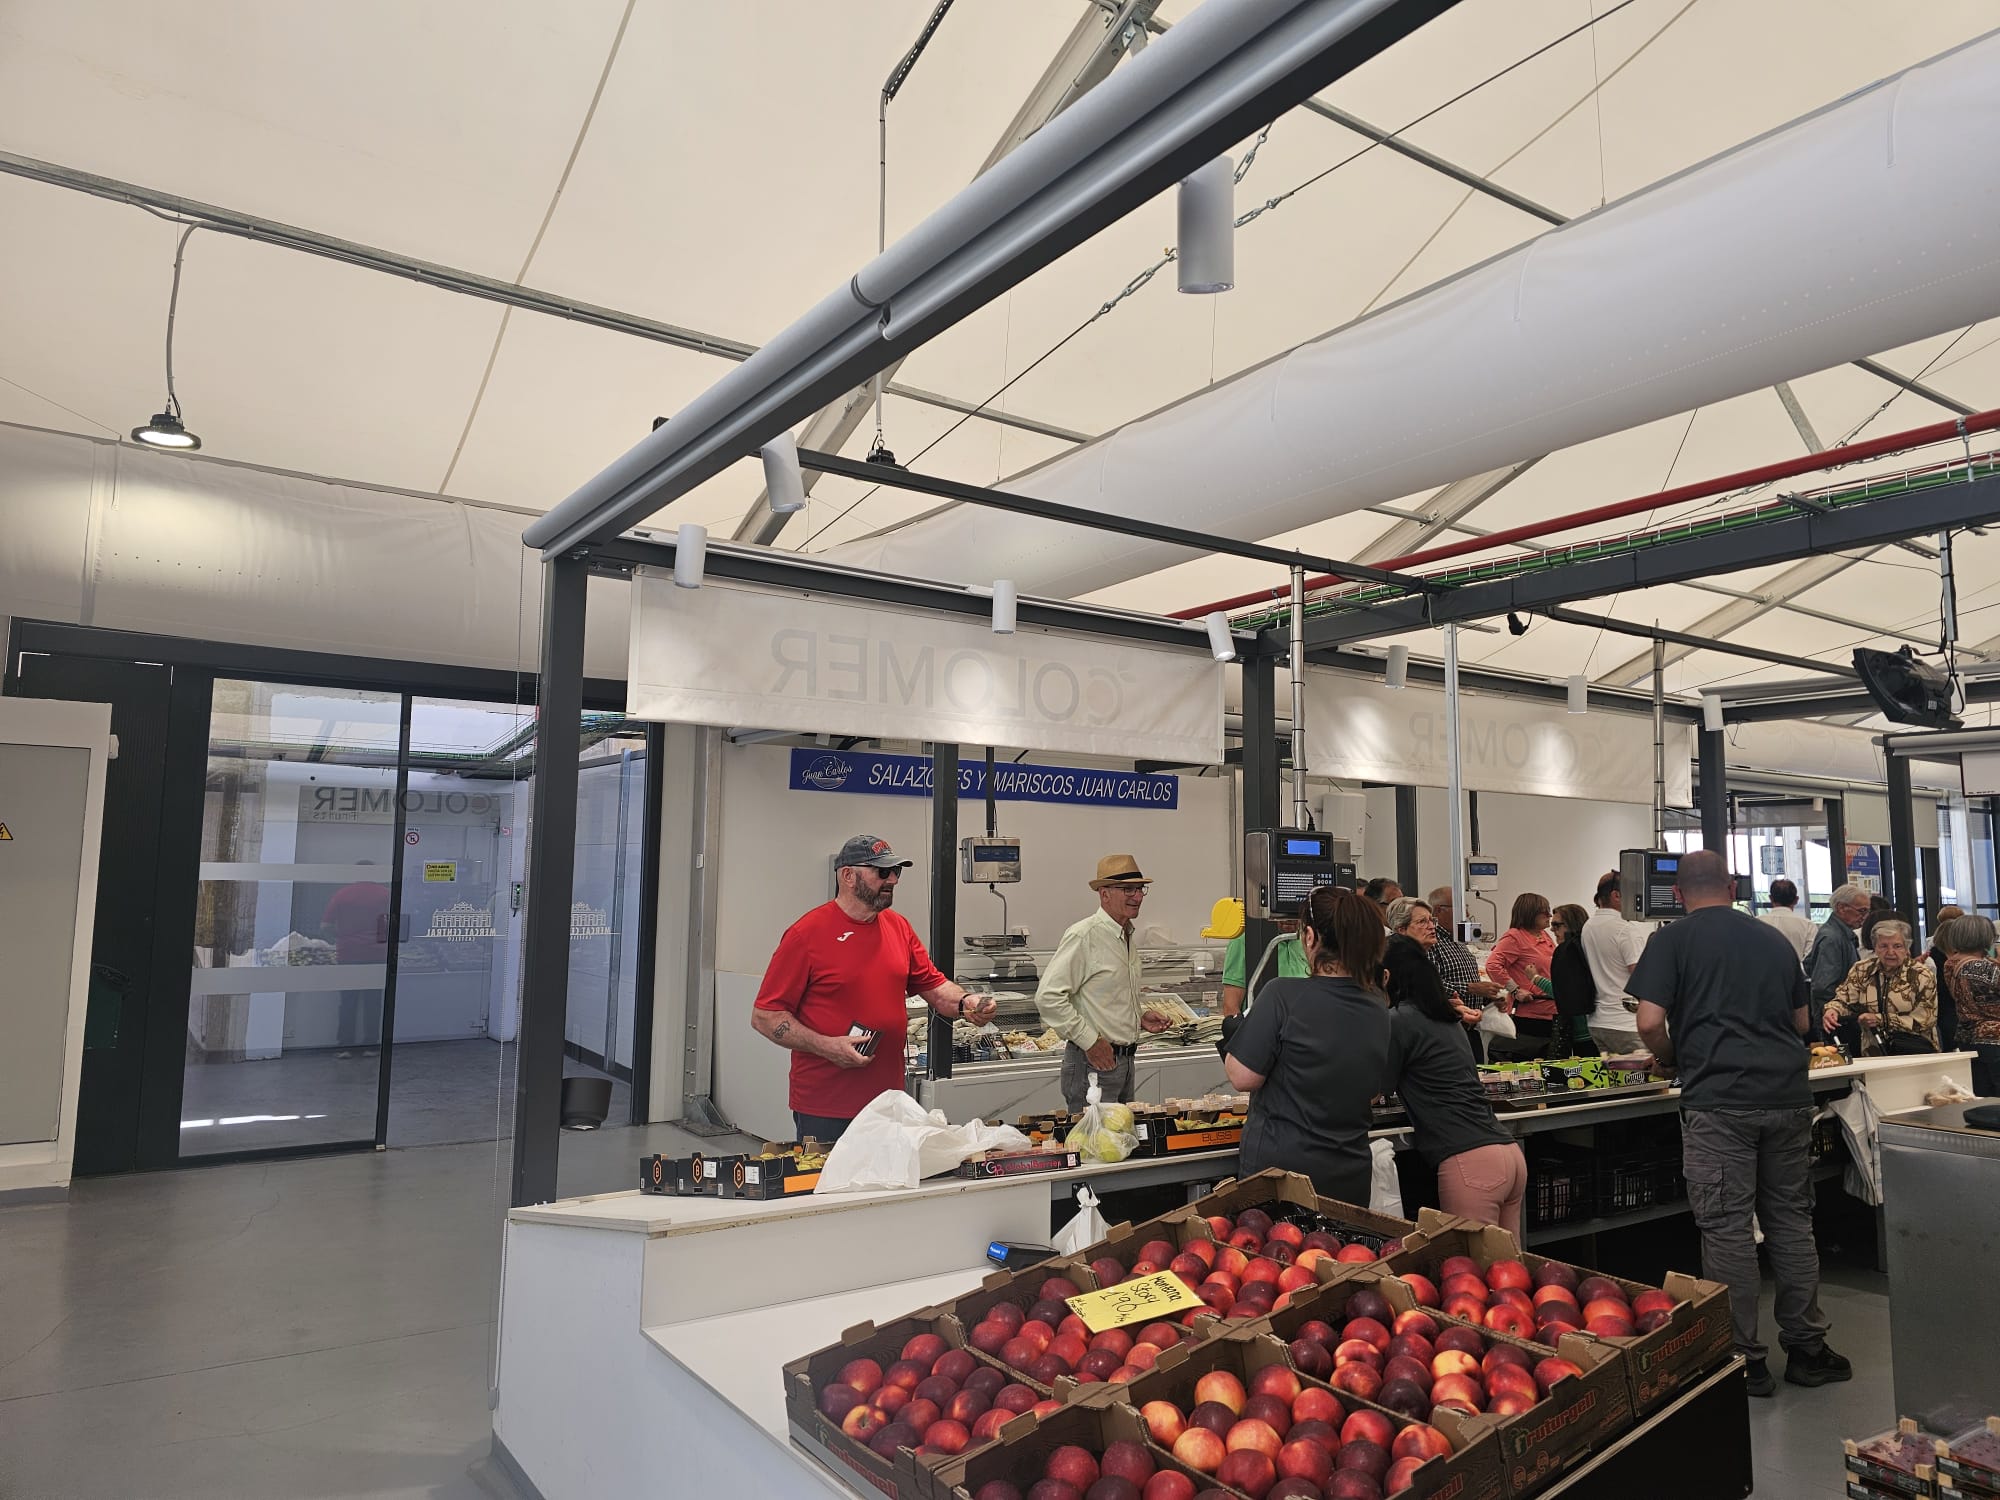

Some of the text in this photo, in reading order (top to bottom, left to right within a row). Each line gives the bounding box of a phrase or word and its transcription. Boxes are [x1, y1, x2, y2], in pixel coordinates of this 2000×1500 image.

[868, 763, 1172, 801] SALAZOES Y MARISCOS JUAN CARLOS
